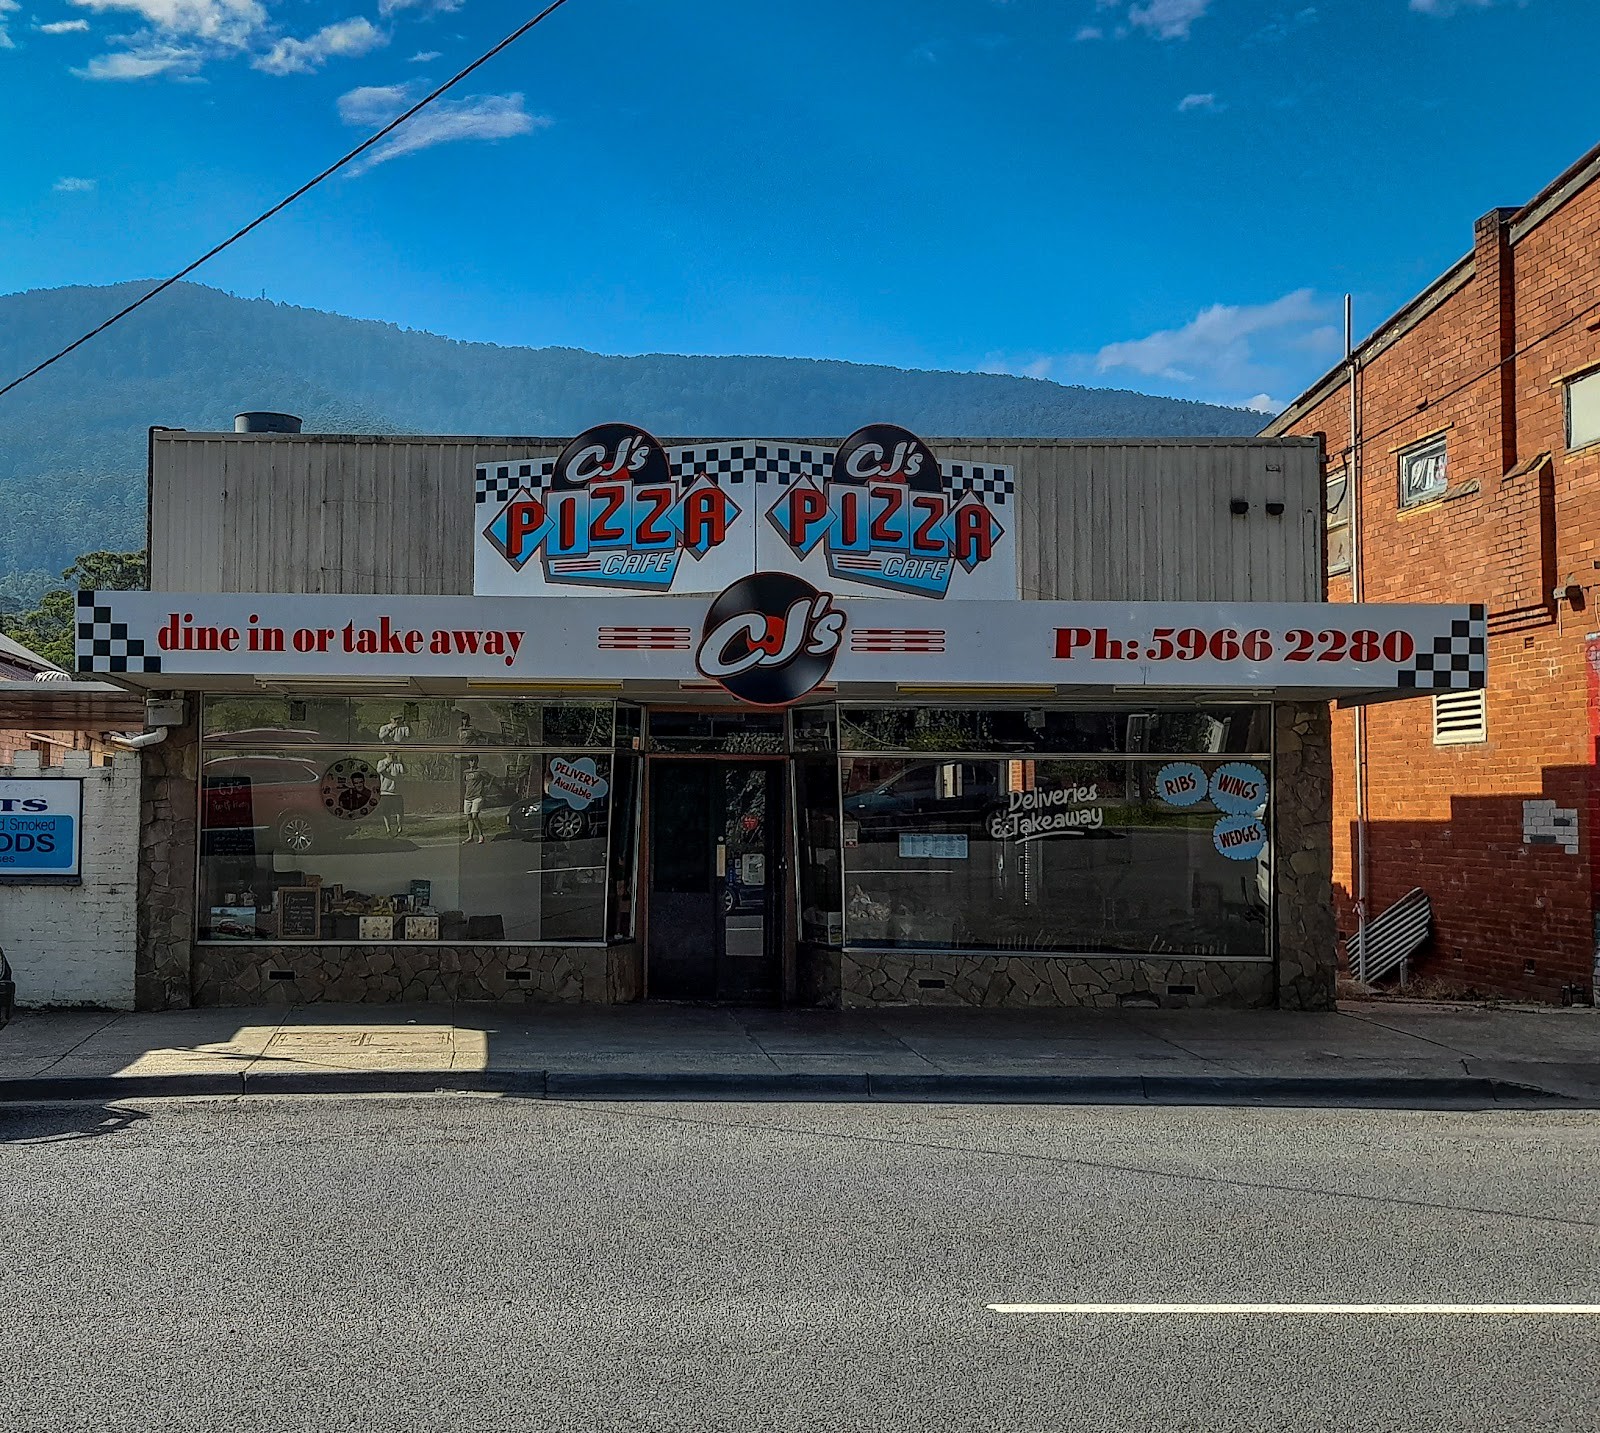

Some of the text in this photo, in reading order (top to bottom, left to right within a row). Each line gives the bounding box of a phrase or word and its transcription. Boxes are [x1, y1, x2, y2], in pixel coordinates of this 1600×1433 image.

[566, 436, 649, 482] CJ's
[846, 442, 924, 478] CJ's
[507, 485, 726, 558] PIZZA
[789, 487, 992, 561] PIZZA
[602, 554, 674, 575] CAFE
[883, 558, 949, 580] CAFE
[157, 613, 526, 667] dine in or take away
[697, 595, 846, 679] CJ's
[1052, 627, 1414, 662] Ph: 5966 2280
[554, 762, 600, 787] DELIVERY
[554, 777, 592, 799] Available
[1164, 772, 1196, 795] RIBS
[1218, 774, 1259, 800] WINGS
[1008, 783, 1098, 812] Deliveries
[10, 818, 56, 831] Smoked
[1006, 808, 1103, 836] Takeaway
[1219, 823, 1261, 848] WEDGES
